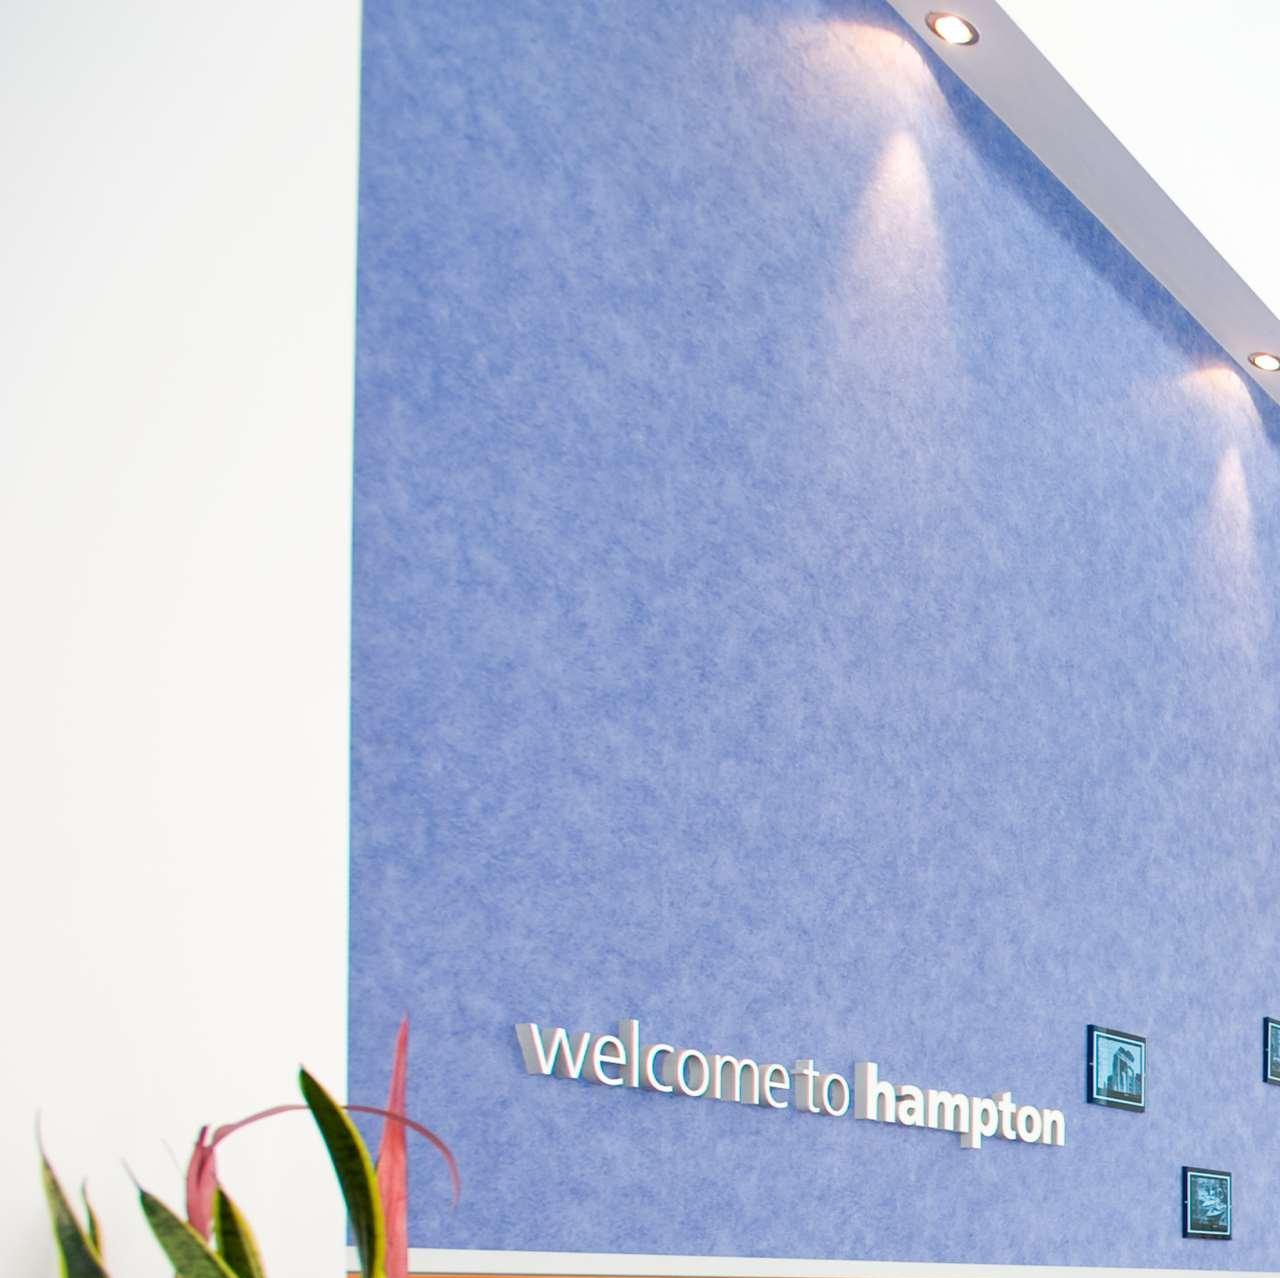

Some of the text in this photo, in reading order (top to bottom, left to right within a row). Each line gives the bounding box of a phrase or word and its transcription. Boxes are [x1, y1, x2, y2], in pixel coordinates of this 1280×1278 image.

[515, 1019, 1066, 1149] welcome to hampton
